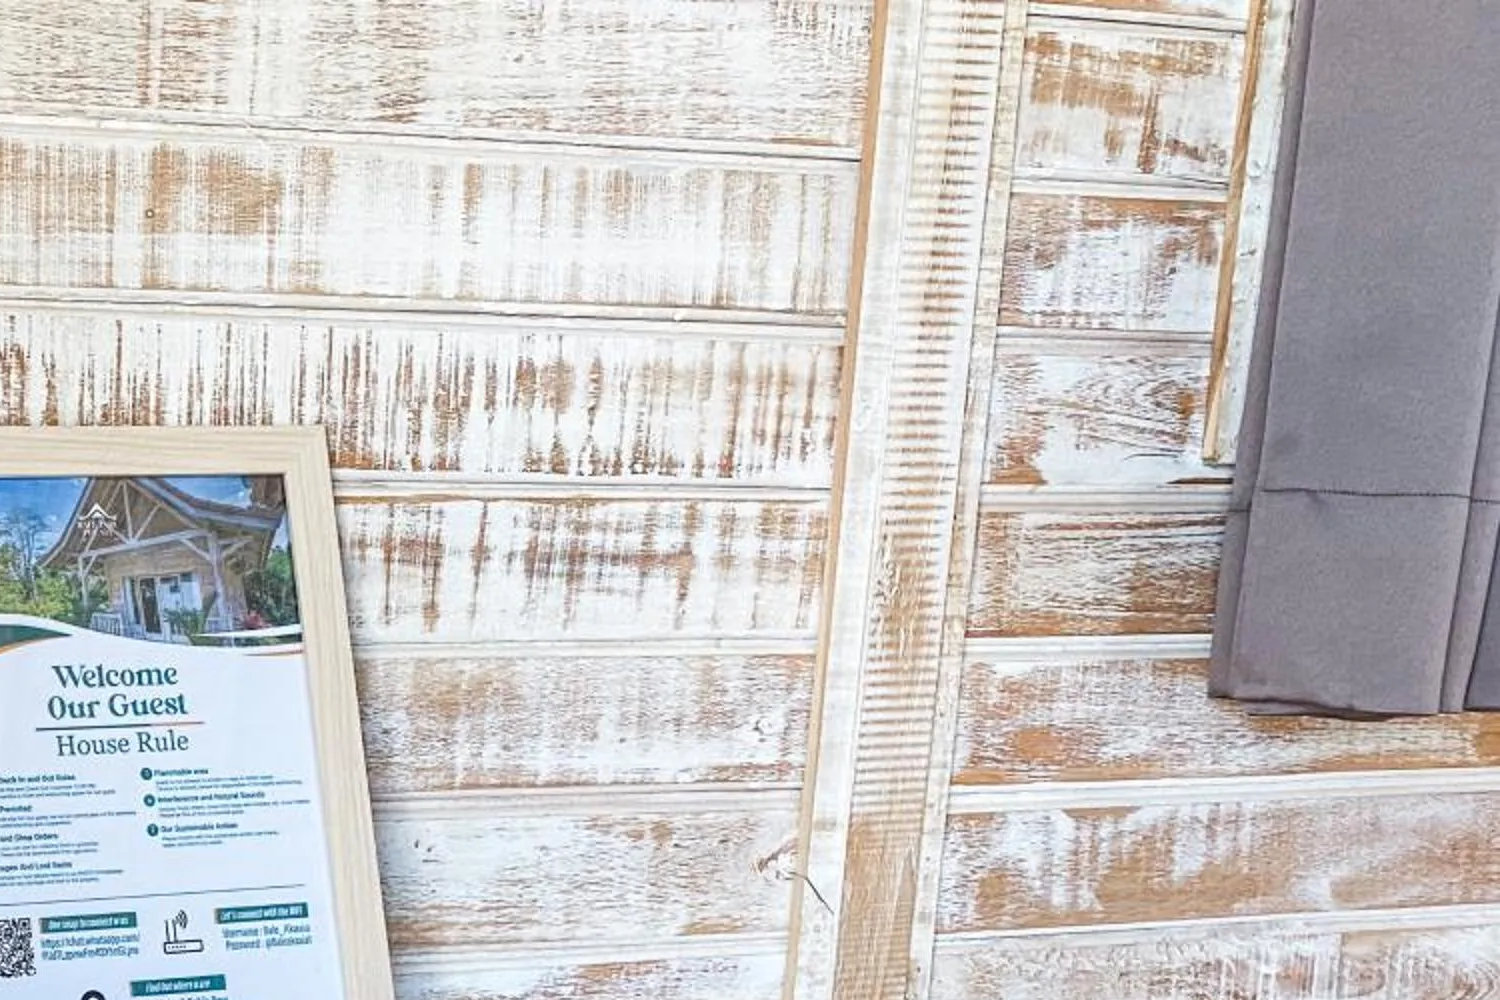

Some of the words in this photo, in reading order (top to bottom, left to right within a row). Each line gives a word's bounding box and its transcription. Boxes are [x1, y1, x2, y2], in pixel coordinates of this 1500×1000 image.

[51, 664, 179, 688] Welcome
[47, 695, 100, 720] Our
[107, 693, 189, 717] Guest
[55, 735, 131, 756] House
[136, 729, 190, 753] Rule
